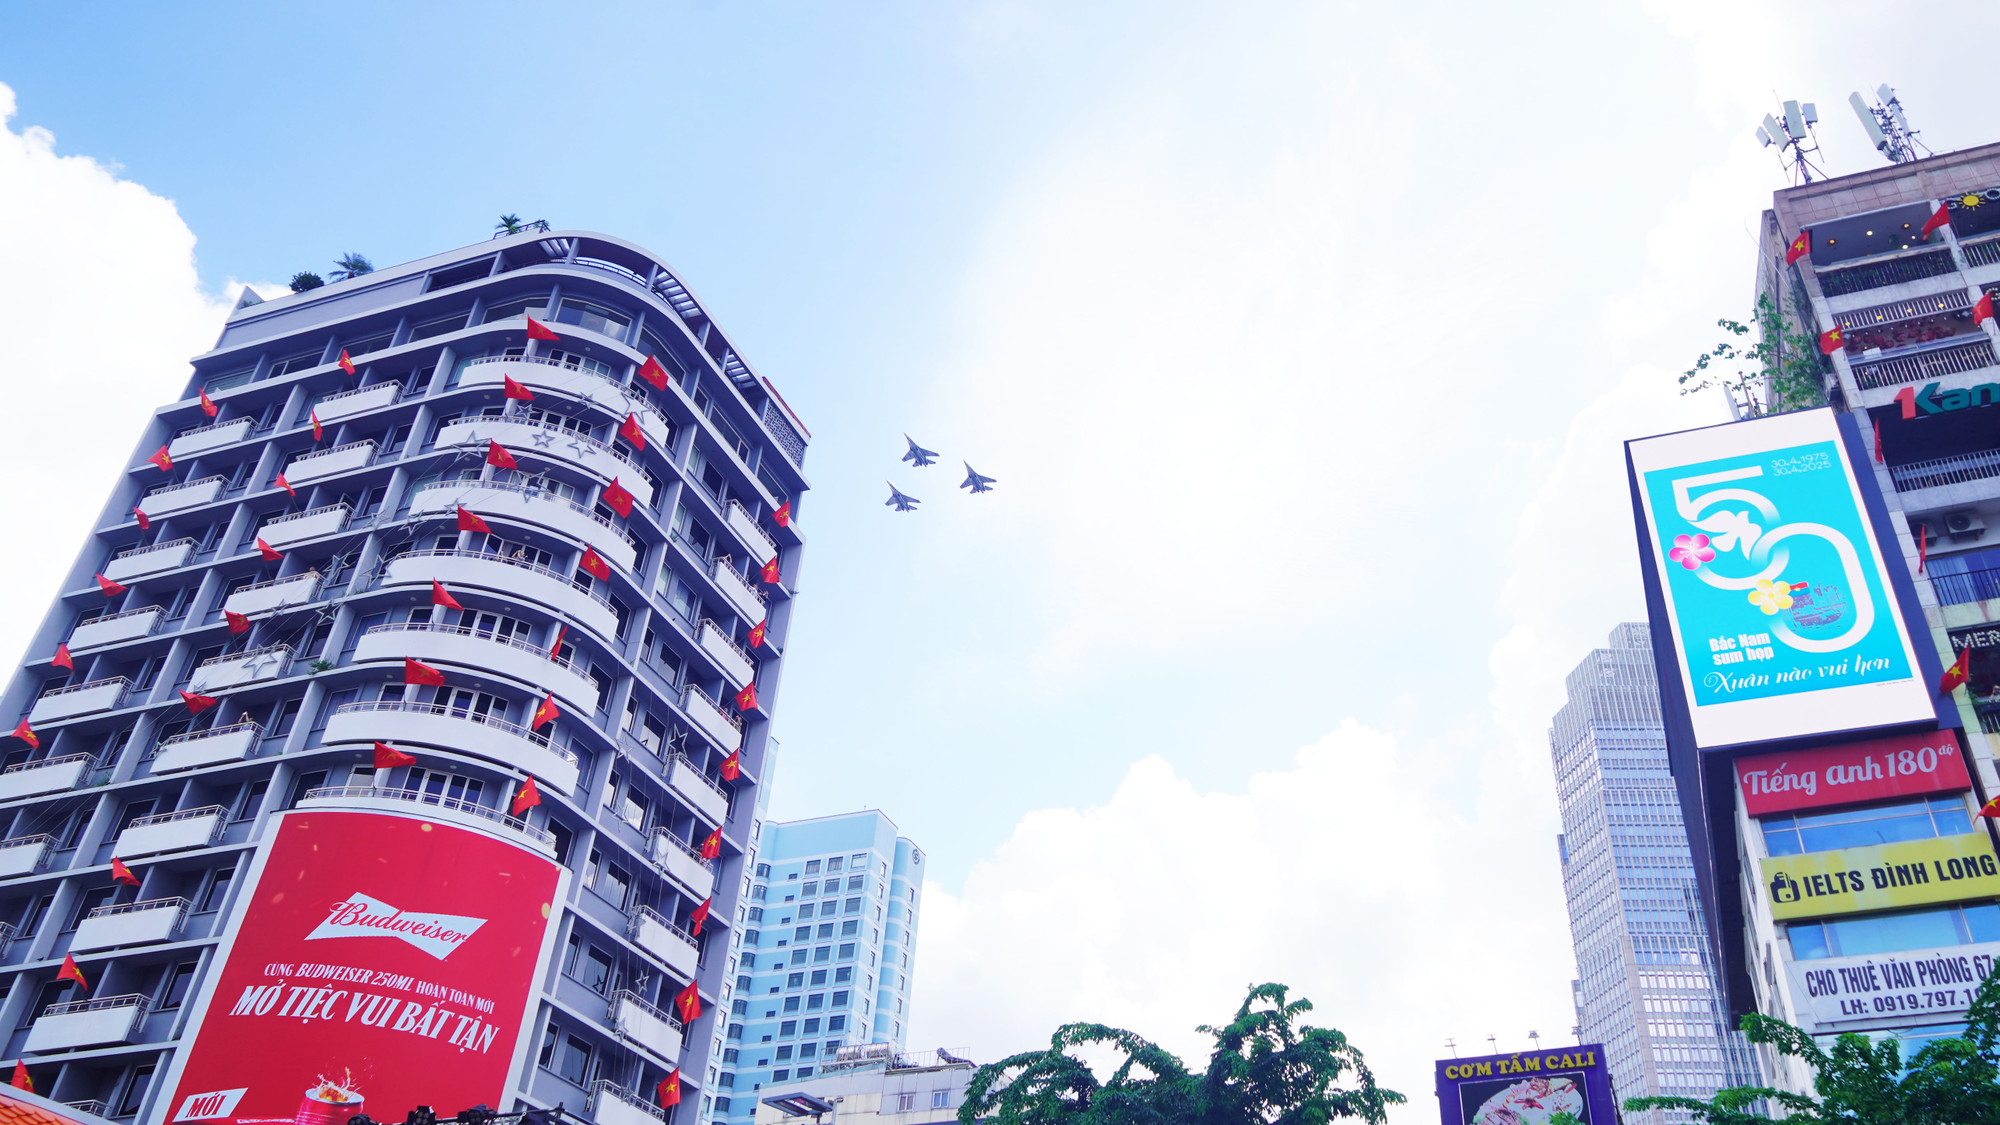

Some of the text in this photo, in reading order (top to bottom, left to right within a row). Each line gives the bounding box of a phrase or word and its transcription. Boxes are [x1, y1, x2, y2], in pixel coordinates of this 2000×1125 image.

[1771, 452, 1829, 468] 30.4.1975
[1773, 460, 1832, 476] 30.4.2025
[1709, 632, 1771, 652] Bắc Nam
[1712, 645, 1775, 666] sum họp
[1703, 653, 1890, 694] Xuân nào vui hơn
[1743, 744, 1954, 796] Tiếng anh 180 độ
[1803, 854, 1998, 897] IELTS ĐÌNH LONG
[329, 900, 468, 944] Budweiser
[264, 961, 496, 1015] CÙNG BUDWEISER 250ML HOÀN TOÀN MỚI
[1805, 968, 1838, 998] CHO
[1838, 960, 1881, 994] THUÊ
[1879, 958, 1916, 990] VĂN
[1915, 952, 1974, 987] PHÒNG
[228, 979, 501, 1054] MỞ TIỆC VUI BẤT TẬN
[1840, 998, 1869, 1016] LH:
[1445, 1052, 1596, 1079] CƠM TẤM CALI
[185, 1092, 227, 1118] MỚI
